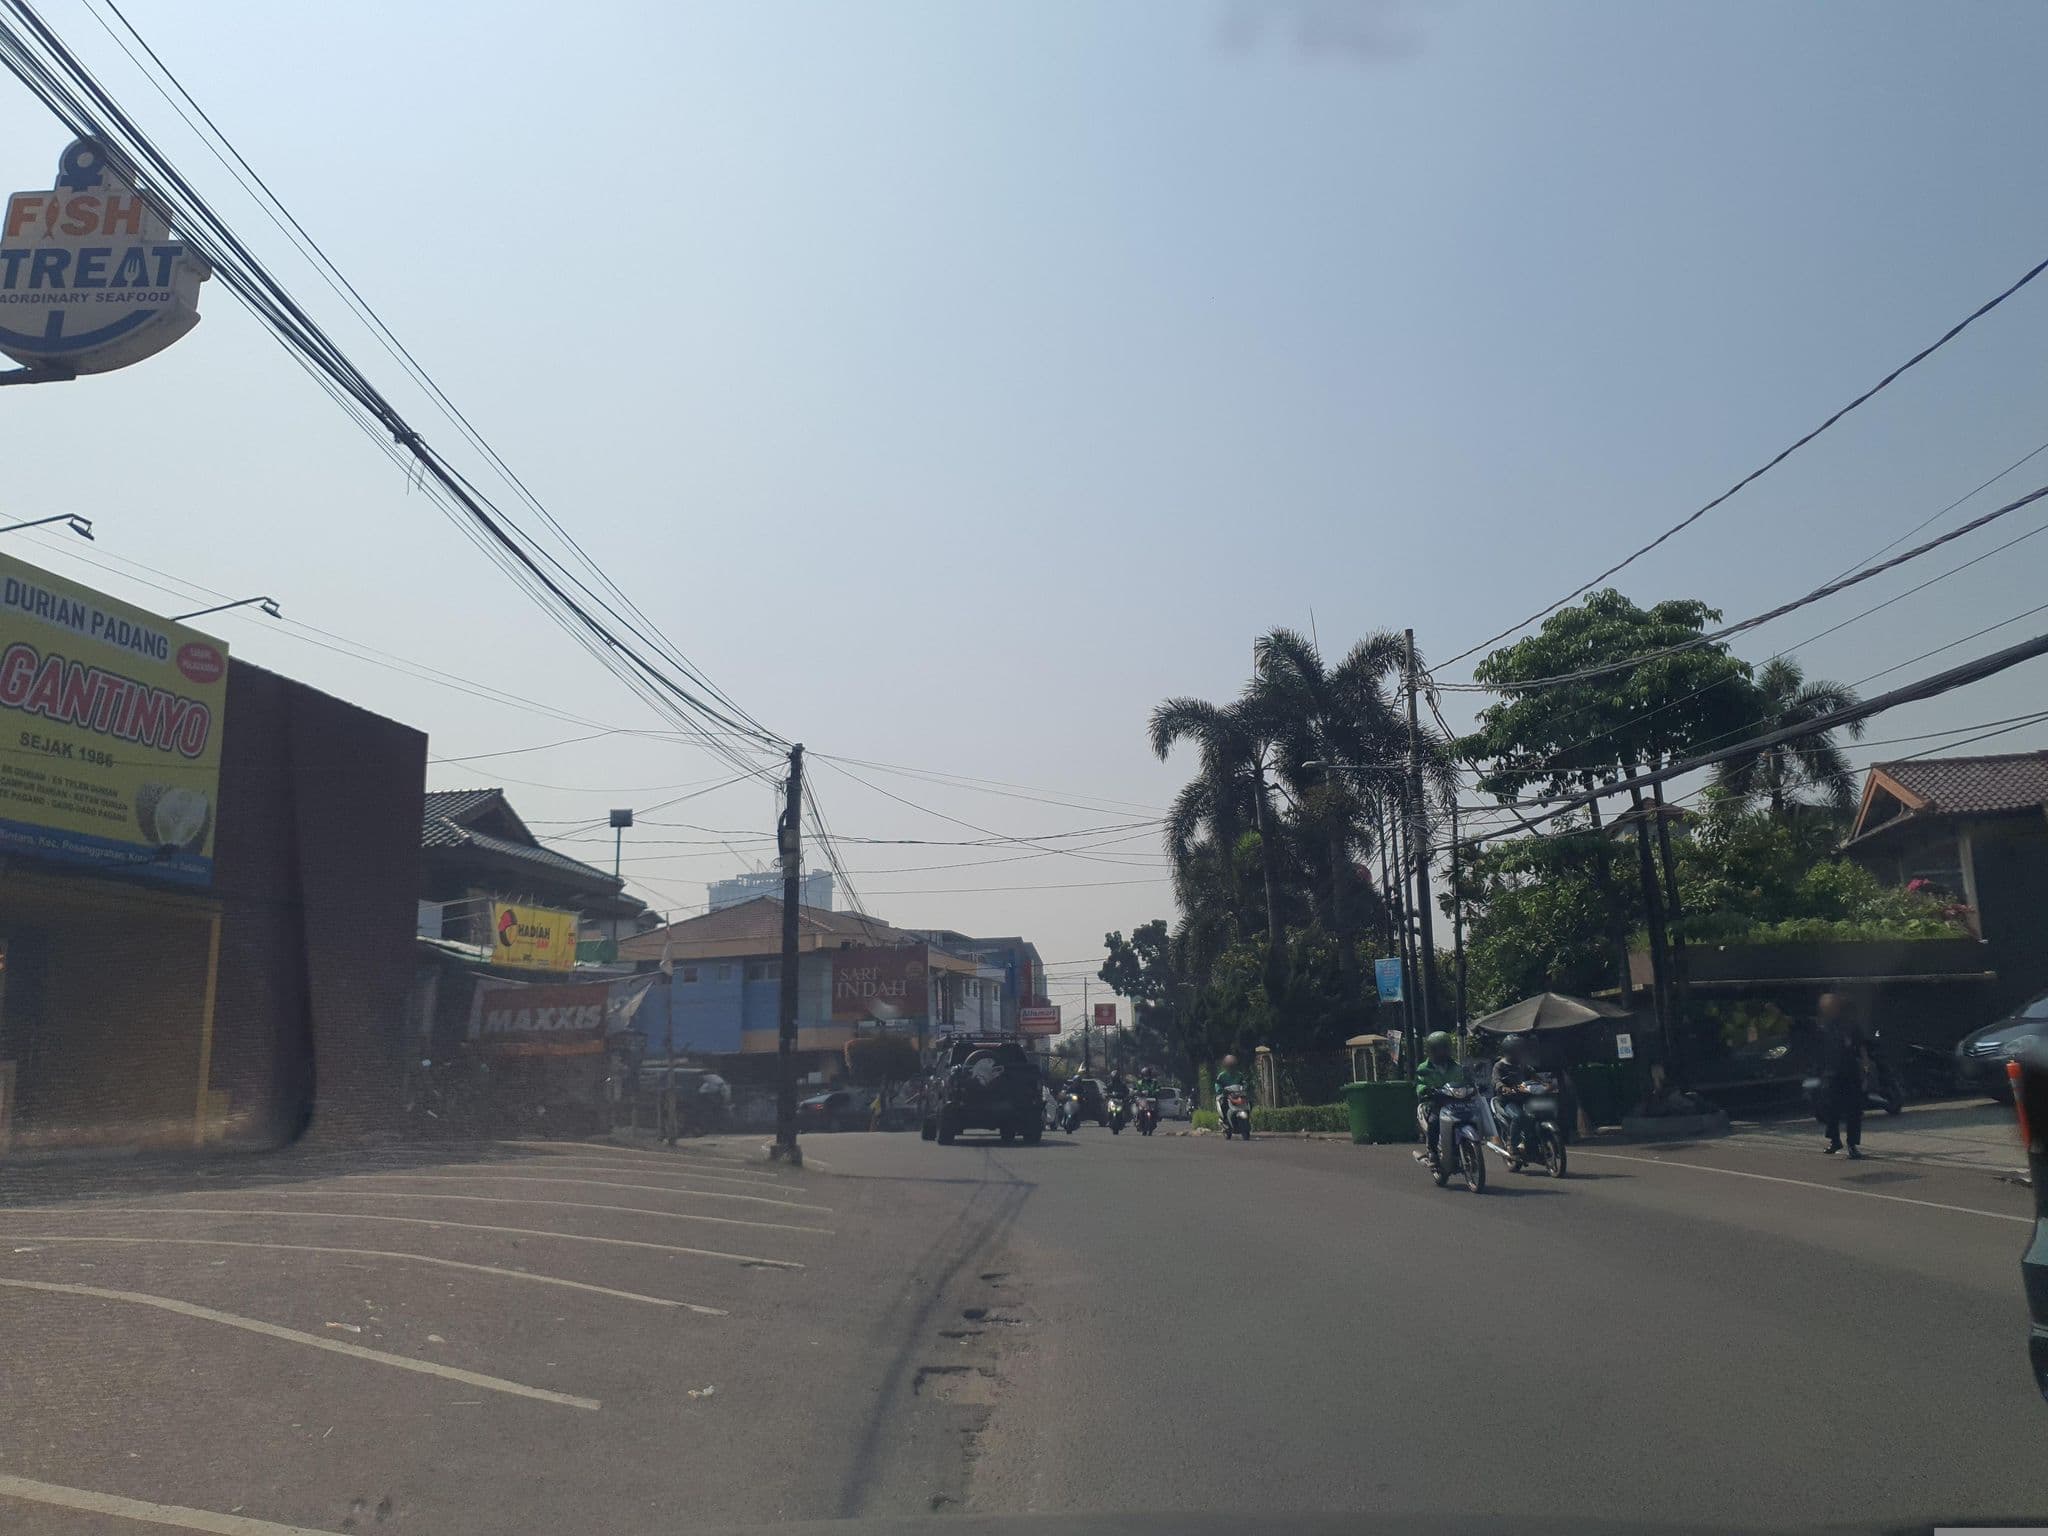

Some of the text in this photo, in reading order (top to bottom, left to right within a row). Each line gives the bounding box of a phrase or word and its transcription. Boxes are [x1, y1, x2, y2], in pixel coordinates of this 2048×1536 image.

[7, 194, 145, 240] FISH
[0, 246, 183, 289] TREAT
[95, 292, 170, 303] SEAFOOD
[5, 578, 168, 660] DURIAN PADANG
[0, 644, 210, 757] GANTINYO
[19, 732, 114, 768] SEJAK 1986
[835, 979, 910, 999] INDAH
[485, 1004, 603, 1033] MAXXIS
